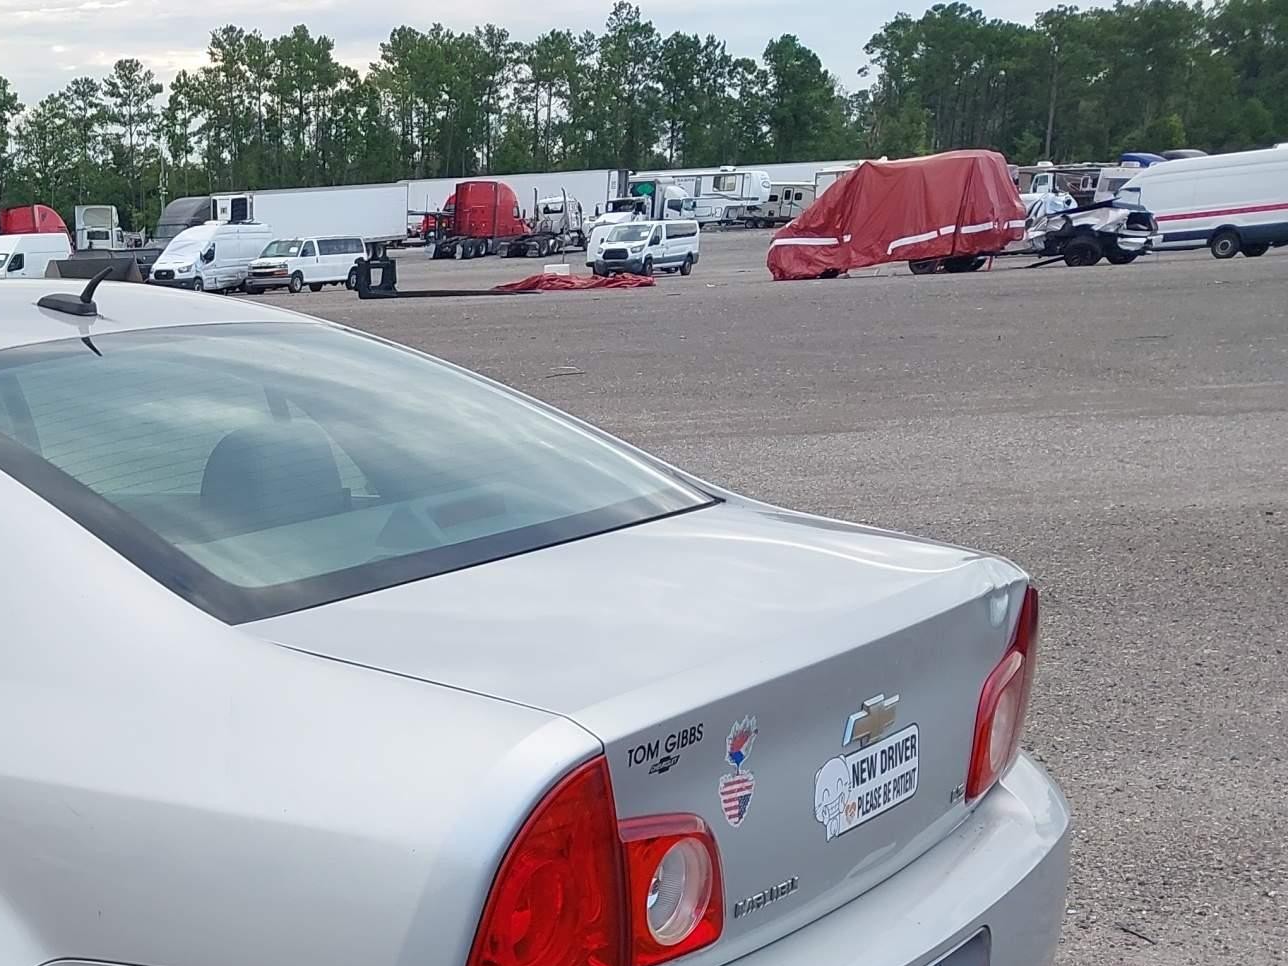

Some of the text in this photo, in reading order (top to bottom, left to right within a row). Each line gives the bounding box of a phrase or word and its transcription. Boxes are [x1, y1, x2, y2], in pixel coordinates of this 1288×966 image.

[627, 722, 704, 768] TOM GIBBS
[852, 734, 917, 788] NEW DRIVER
[856, 767, 917, 818] PLEASE BE PATIENT
